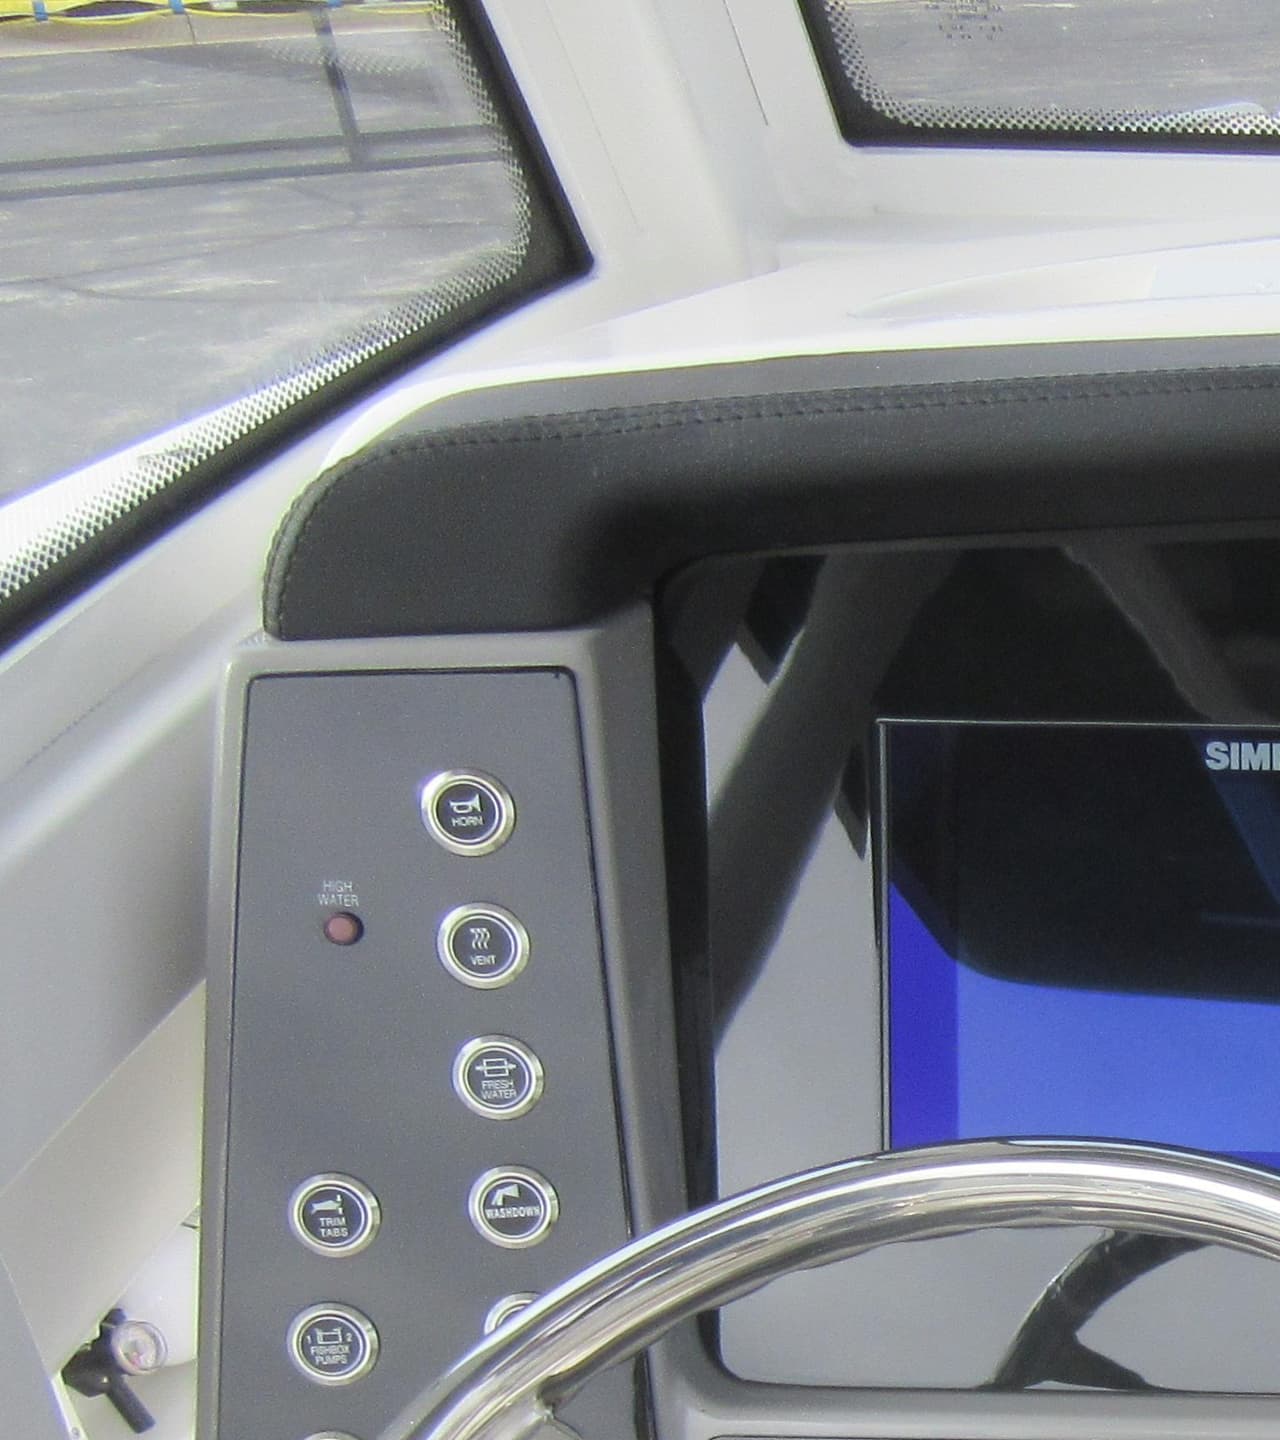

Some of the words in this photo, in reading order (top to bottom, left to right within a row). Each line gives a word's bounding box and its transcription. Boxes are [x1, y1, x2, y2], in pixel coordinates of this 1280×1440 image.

[451, 816, 483, 827] HORN
[323, 880, 353, 893] HIGH
[318, 893, 360, 907] WATER
[470, 955, 497, 966] VENT
[481, 1079, 514, 1090] FRESH
[481, 1089, 517, 1100] WATER
[485, 1206, 541, 1219] WASHDOWN
[319, 1217, 346, 1228] TRIM
[319, 1227, 349, 1238] TABS
